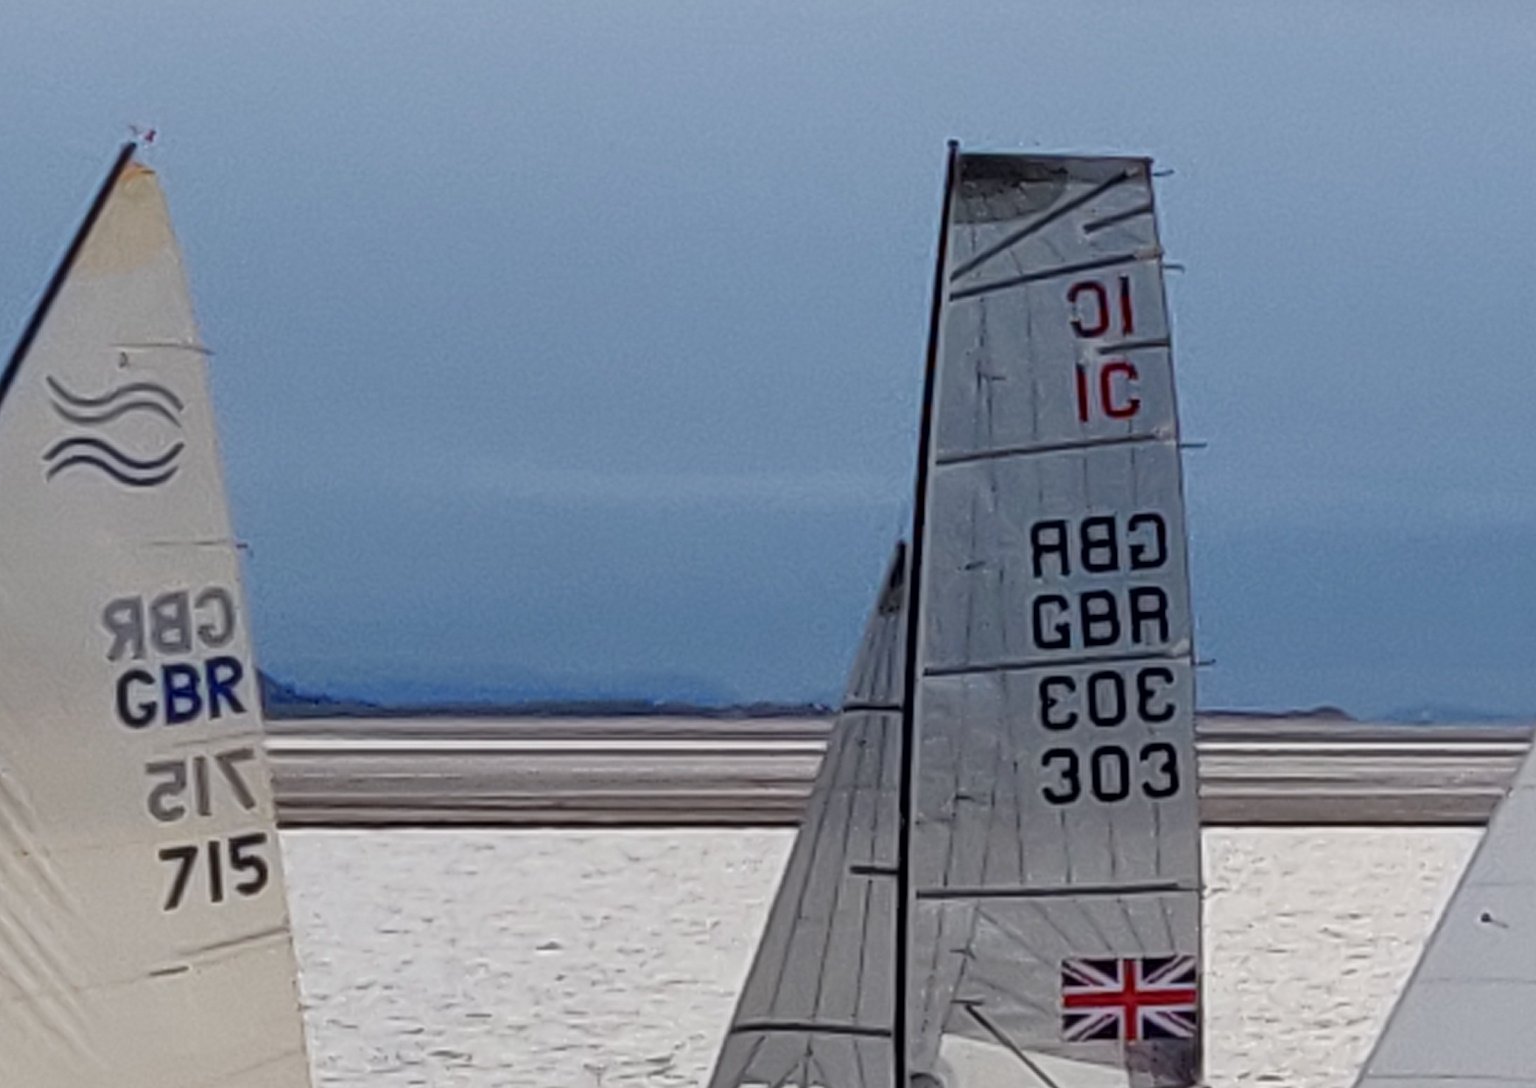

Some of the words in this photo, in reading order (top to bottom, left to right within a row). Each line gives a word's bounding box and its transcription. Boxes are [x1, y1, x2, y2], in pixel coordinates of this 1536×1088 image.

[1075, 362, 1141, 421] IC
[1032, 587, 1169, 650] GBR
[116, 656, 246, 728] GBR
[1040, 742, 1180, 804] 303
[158, 834, 268, 911] 715
